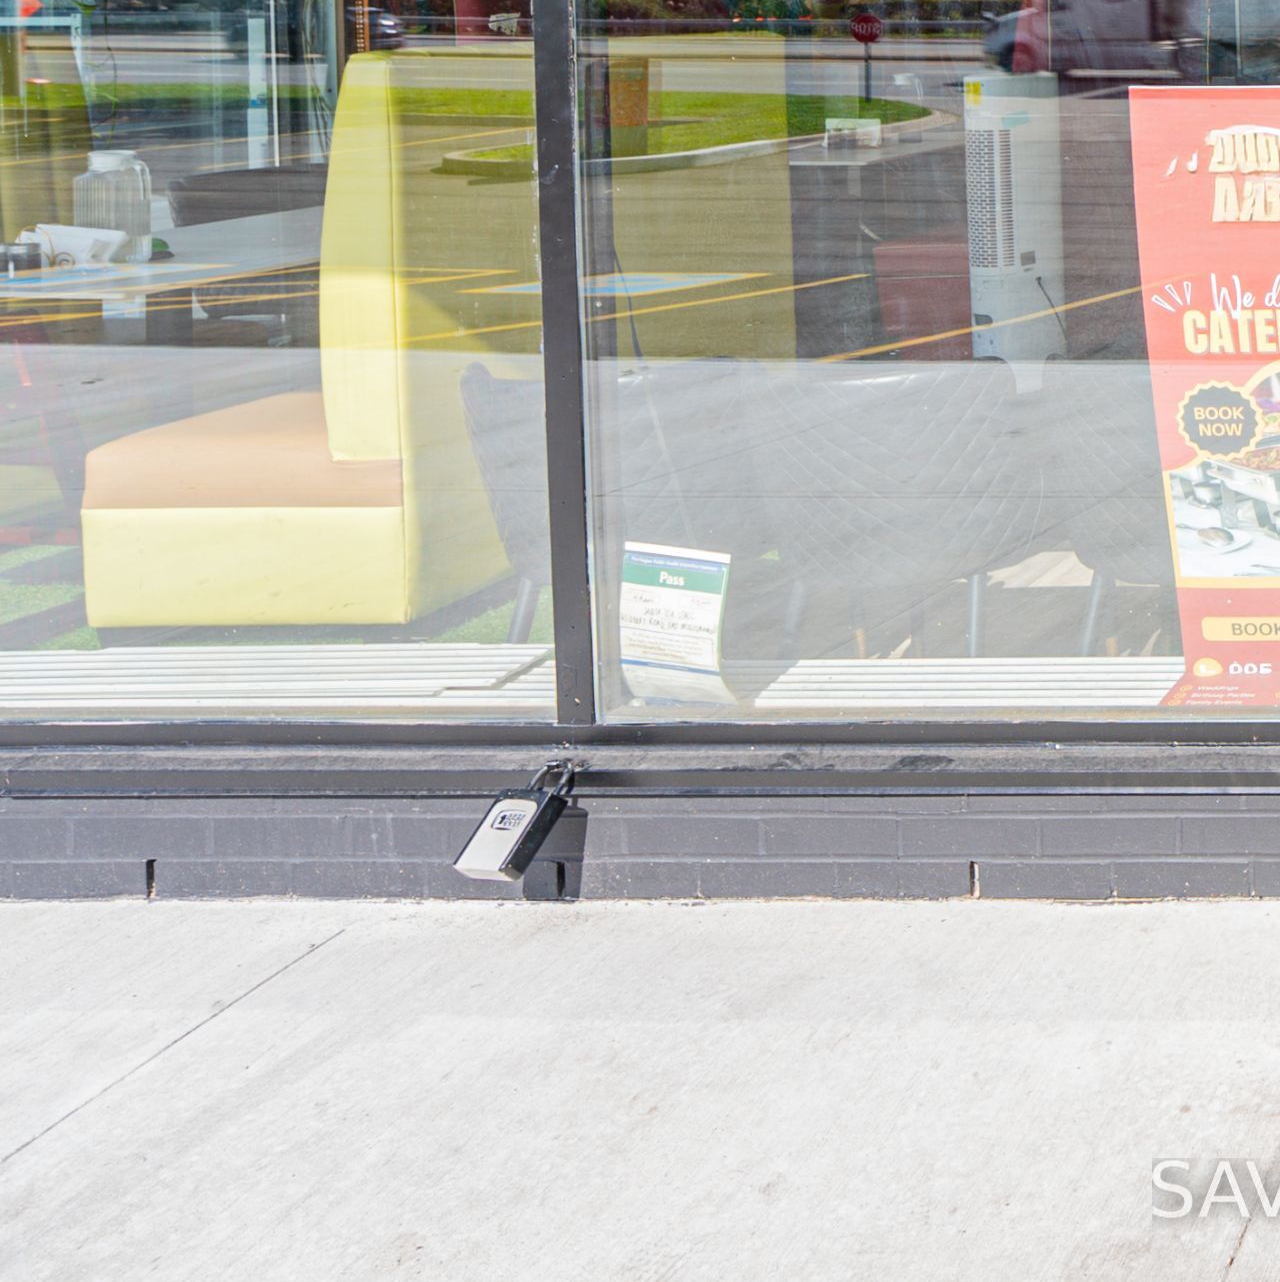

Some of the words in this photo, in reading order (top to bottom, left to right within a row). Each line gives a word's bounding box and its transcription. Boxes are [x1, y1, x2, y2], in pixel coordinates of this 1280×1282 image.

[1210, 272, 1255, 319] We
[1194, 406, 1244, 421] BOOK
[1198, 422, 1243, 437] NOW
[659, 570, 685, 587] Pass
